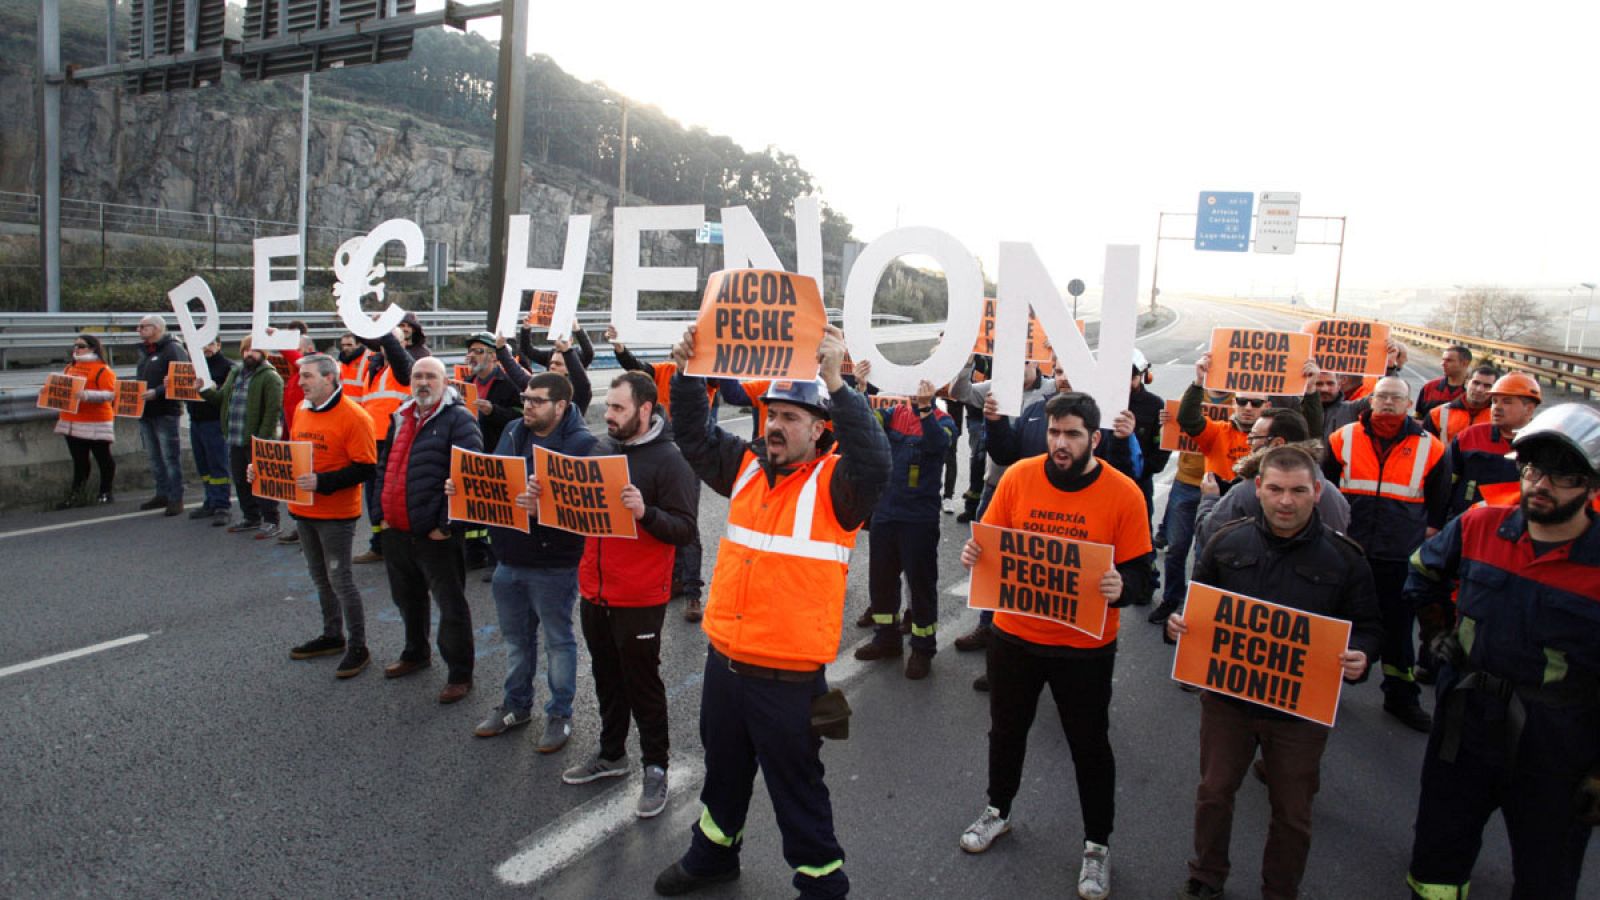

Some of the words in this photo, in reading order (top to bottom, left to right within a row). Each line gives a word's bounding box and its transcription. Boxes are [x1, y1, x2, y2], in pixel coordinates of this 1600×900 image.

[716, 271, 798, 306] ALCOA
[715, 308, 796, 342] PECHE
[1317, 321, 1371, 340] ALCOA
[1229, 330, 1290, 353] ALCOA
[1315, 337, 1369, 356] PECHE
[712, 343, 794, 377] NON!!!
[1228, 351, 1288, 373] PECHE
[1313, 354, 1367, 374] NON!!!
[1225, 372, 1286, 394] NON!!!
[1201, 404, 1228, 421] COA
[254, 440, 293, 463] ALCOA
[256, 461, 295, 482] PECHE
[460, 453, 507, 480] ALCOA
[547, 453, 604, 484] ALCOA
[260, 479, 297, 501] NON!!!
[462, 476, 511, 504] PECHE
[550, 480, 608, 510] PECHE
[465, 498, 515, 526] NON!!!
[555, 503, 614, 534] NON!!!
[1030, 509, 1086, 525] ENERXÍA
[1023, 521, 1089, 539] SOLUCIÓN
[1000, 531, 1082, 569] ALCOA
[1001, 556, 1080, 596] PECHE
[999, 582, 1078, 624] NON!!!
[1214, 595, 1310, 645] ALCOA
[1211, 626, 1307, 677] PECHE
[1206, 657, 1303, 711] NON!!!
